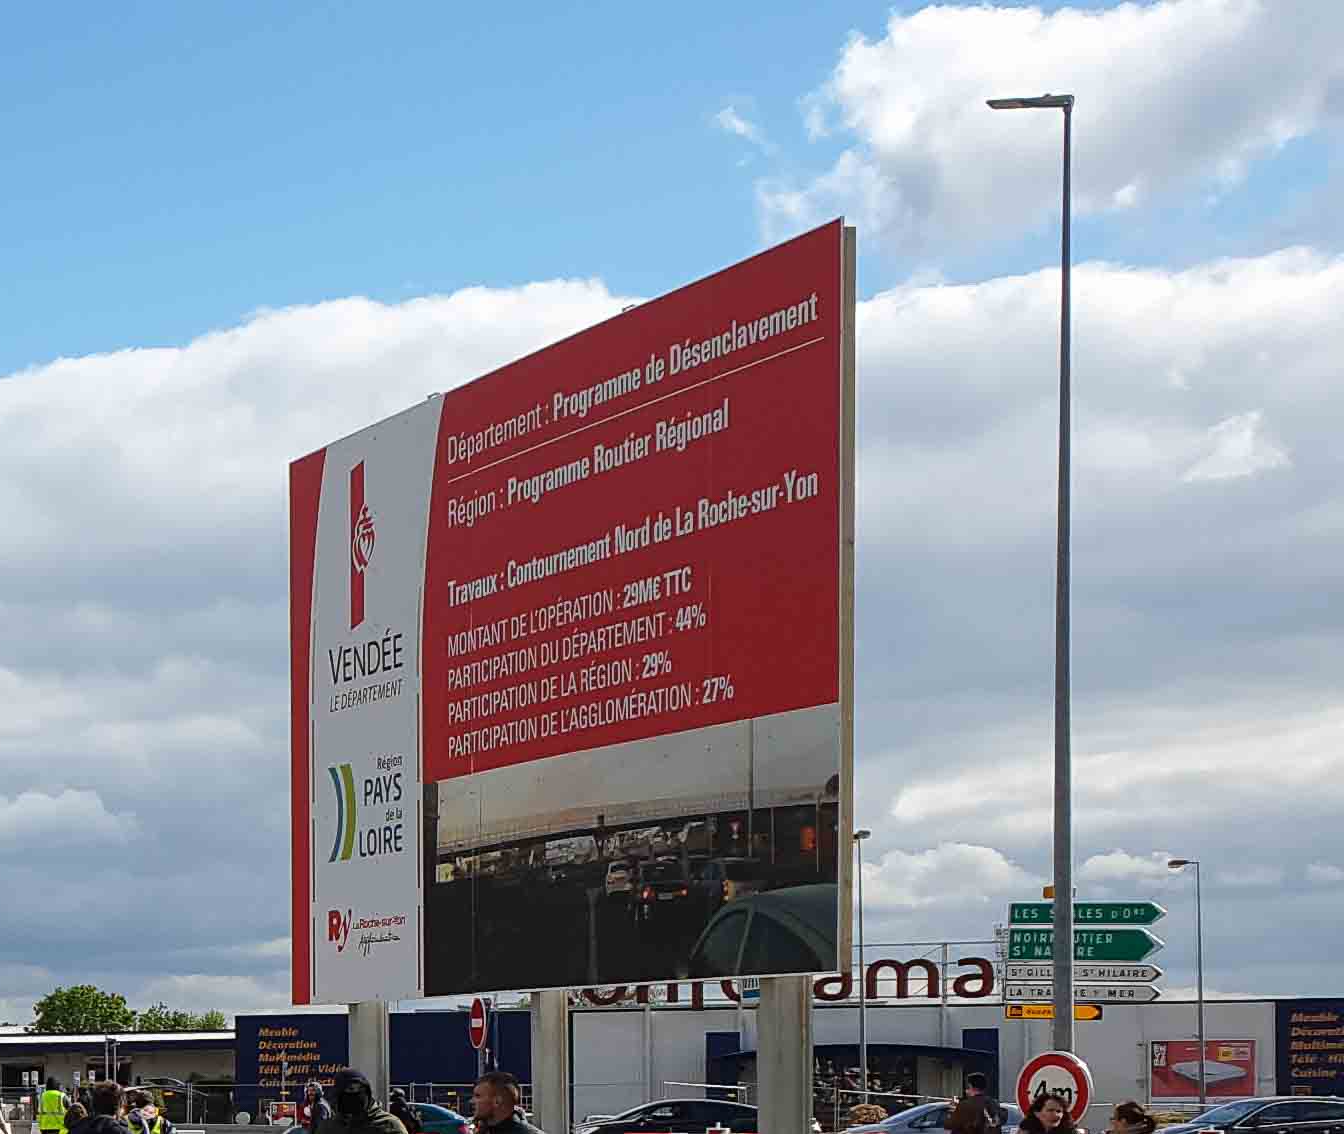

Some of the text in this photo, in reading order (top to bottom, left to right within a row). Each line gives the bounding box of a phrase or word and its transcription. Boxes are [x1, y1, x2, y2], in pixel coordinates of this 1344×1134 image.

[448, 405, 542, 464] Département
[553, 367, 641, 421] Programme
[645, 353, 665, 384] de
[669, 292, 818, 376] Désenclavement
[448, 490, 496, 528] Région
[507, 457, 590, 504] Programme
[593, 432, 652, 474] Routier
[655, 397, 729, 451] Régional
[448, 573, 498, 607] Travaux
[507, 532, 611, 588] Contournement
[615, 516, 650, 555] Nord
[653, 512, 672, 543] de
[675, 507, 694, 537] La
[697, 469, 818, 529] Roche-sur-Yon
[448, 620, 509, 657] MONTANT
[512, 613, 528, 639] DE
[531, 590, 613, 634] L'OPÉRATION
[623, 576, 661, 608] 29M€
[664, 566, 693, 597] TTC
[448, 646, 537, 692] PARTICIPATION
[541, 640, 559, 667] DU
[563, 611, 667, 661] DÉPARTEMENT
[676, 602, 706, 631] 44%
[329, 628, 403, 685] VENDÉE
[448, 681, 537, 726] PARTICIPATION
[541, 676, 559, 702] DE
[561, 672, 578, 697] LA
[580, 658, 632, 692] RÉGION
[642, 650, 672, 679] 29%
[330, 679, 403, 713] LE DÉPARTEMENT
[448, 717, 537, 759] PARTICIPATION
[541, 711, 558, 737] DE
[561, 681, 691, 734] L'AGGLOMÉRATION
[702, 674, 734, 704] 27%
[364, 773, 402, 807] PAYS
[377, 755, 403, 771] Région
[359, 824, 403, 858] LOIRE
[1015, 908, 1039, 919] LES
